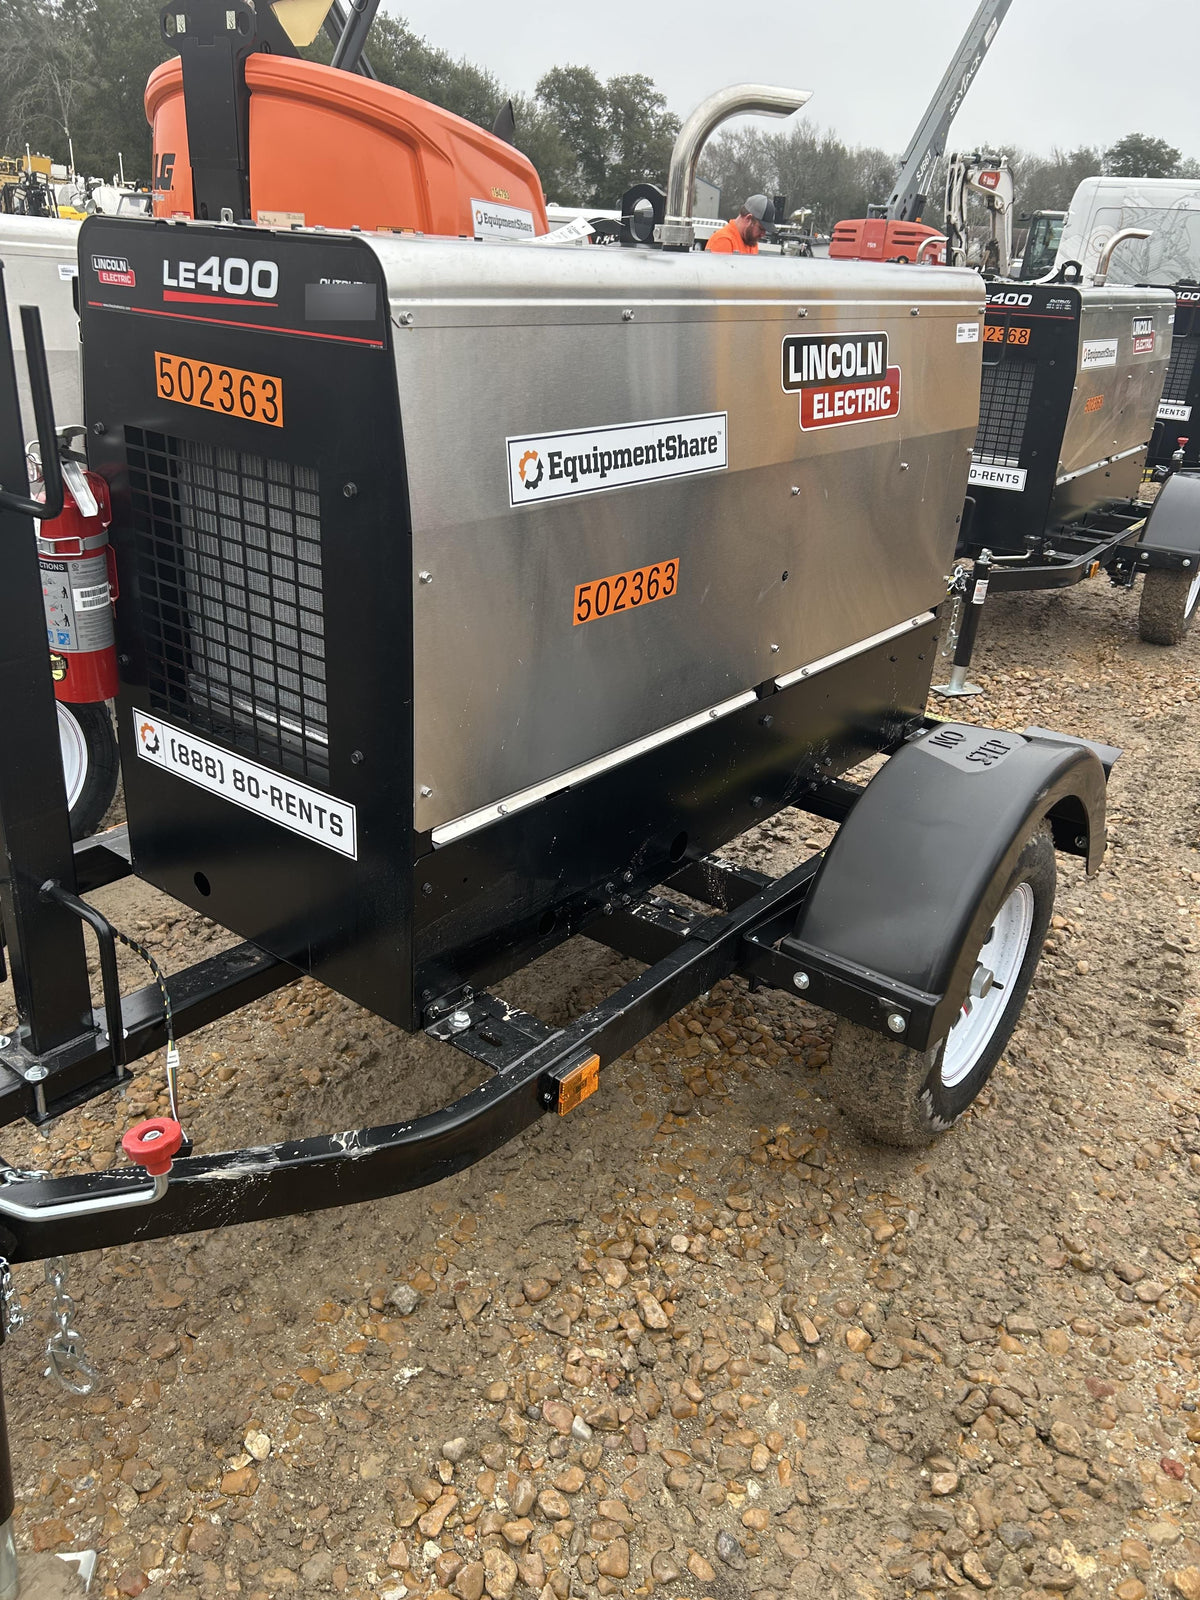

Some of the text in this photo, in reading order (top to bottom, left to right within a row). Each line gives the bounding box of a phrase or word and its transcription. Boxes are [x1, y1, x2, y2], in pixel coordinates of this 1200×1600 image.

[484, 212, 532, 232] EquipmentShare
[93, 258, 127, 272] LINCOLN
[102, 272, 132, 284] ELECTRIC
[163, 256, 279, 298] LE400
[788, 341, 883, 383] LINCOLN
[159, 356, 279, 423] 502363
[812, 385, 892, 420] ELECTRIC
[547, 434, 718, 483] EquipmentShare
[577, 562, 676, 622] 502363
[170, 738, 344, 838] (888) 80-RENTS
